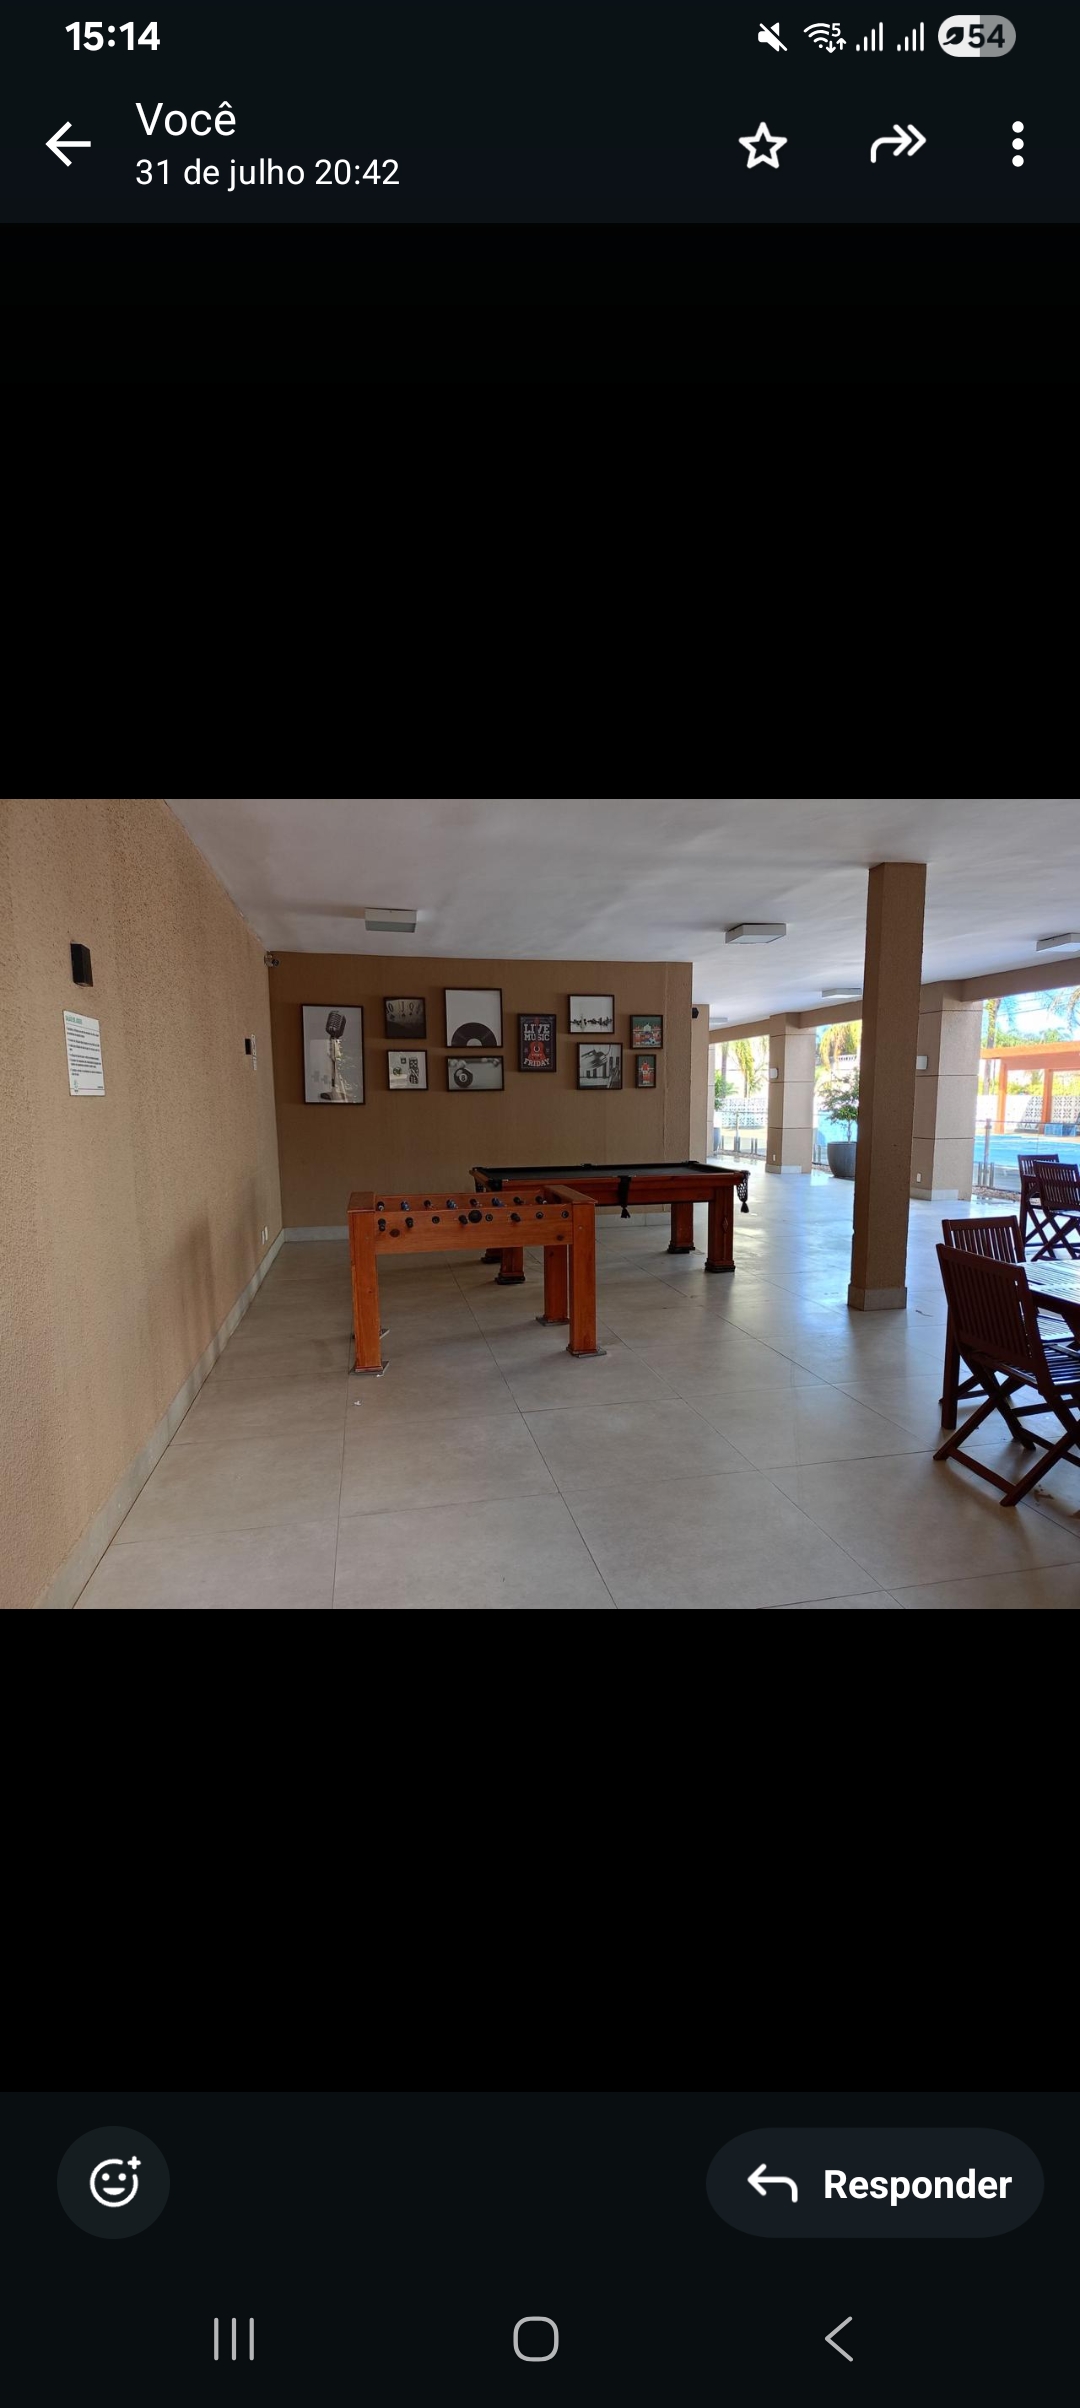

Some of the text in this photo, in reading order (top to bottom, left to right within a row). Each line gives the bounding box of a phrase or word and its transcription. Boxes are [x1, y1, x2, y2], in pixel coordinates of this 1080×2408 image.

[65, 22, 160, 51] 15:14
[831, 22, 841, 37] 5
[968, 24, 1005, 48] 54
[135, 101, 235, 137] Você
[136, 156, 400, 192] 31 de julho 20:42
[524, 1024, 550, 1033] LIVE
[524, 1033, 550, 1042] MUSIC
[523, 1058, 550, 1067] FRIDAY
[825, 2168, 1013, 2207] Responder
